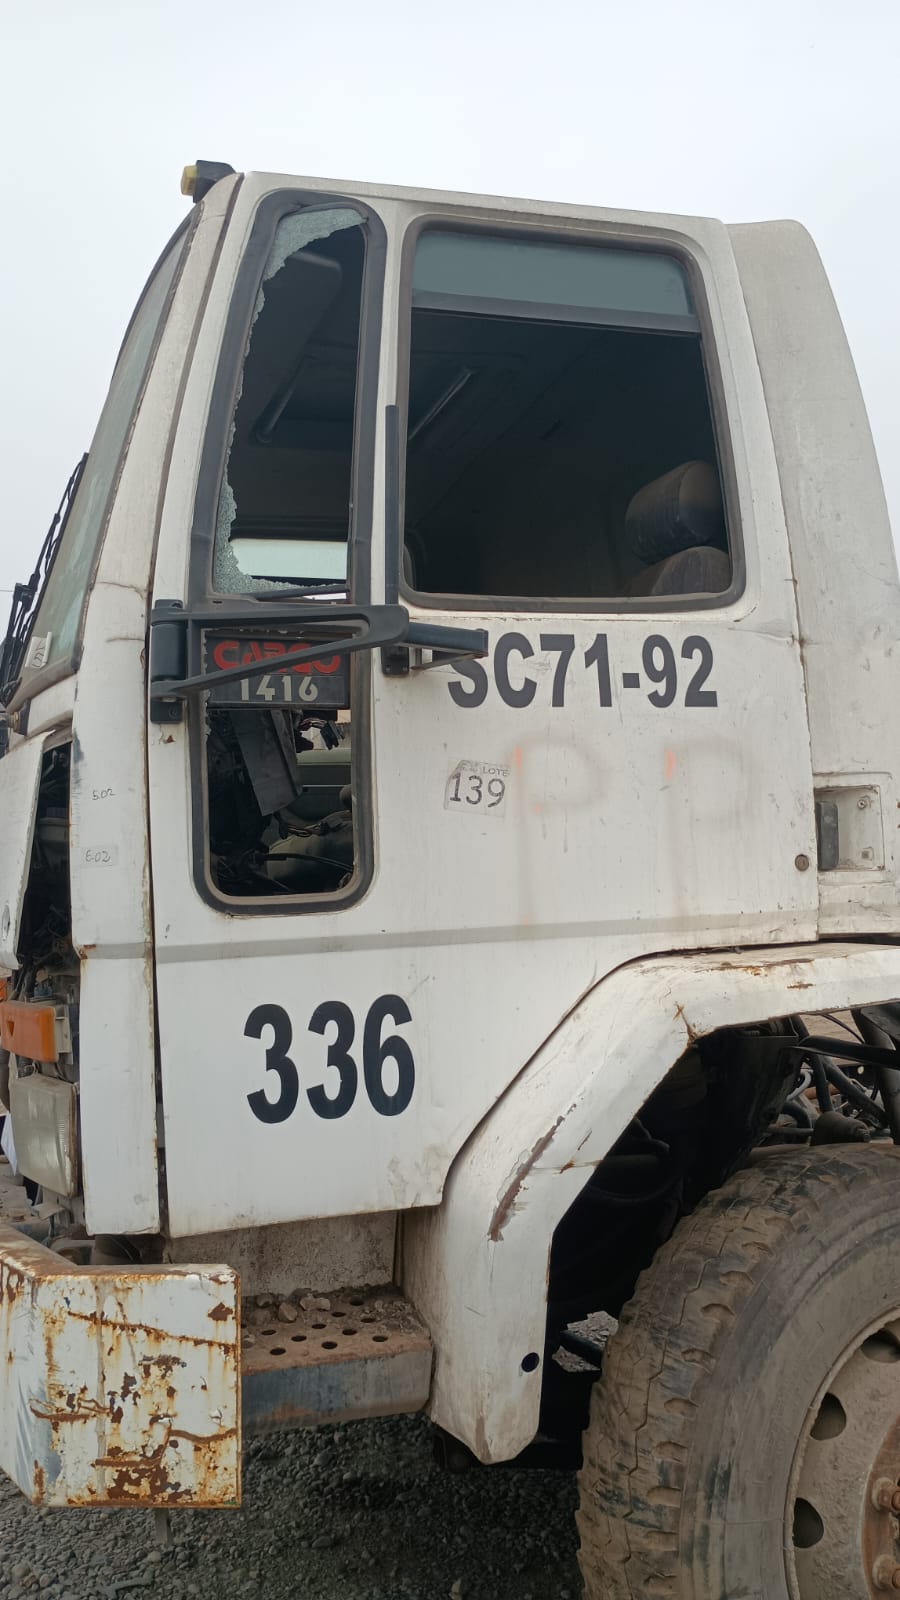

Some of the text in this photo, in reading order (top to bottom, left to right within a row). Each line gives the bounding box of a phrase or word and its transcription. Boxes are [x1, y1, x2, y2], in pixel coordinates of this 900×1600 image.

[240, 674, 319, 702] 1416
[447, 631, 718, 709] SC71-92
[449, 771, 506, 808] 139
[482, 765, 511, 778] LOTE
[243, 993, 416, 1125] 336
